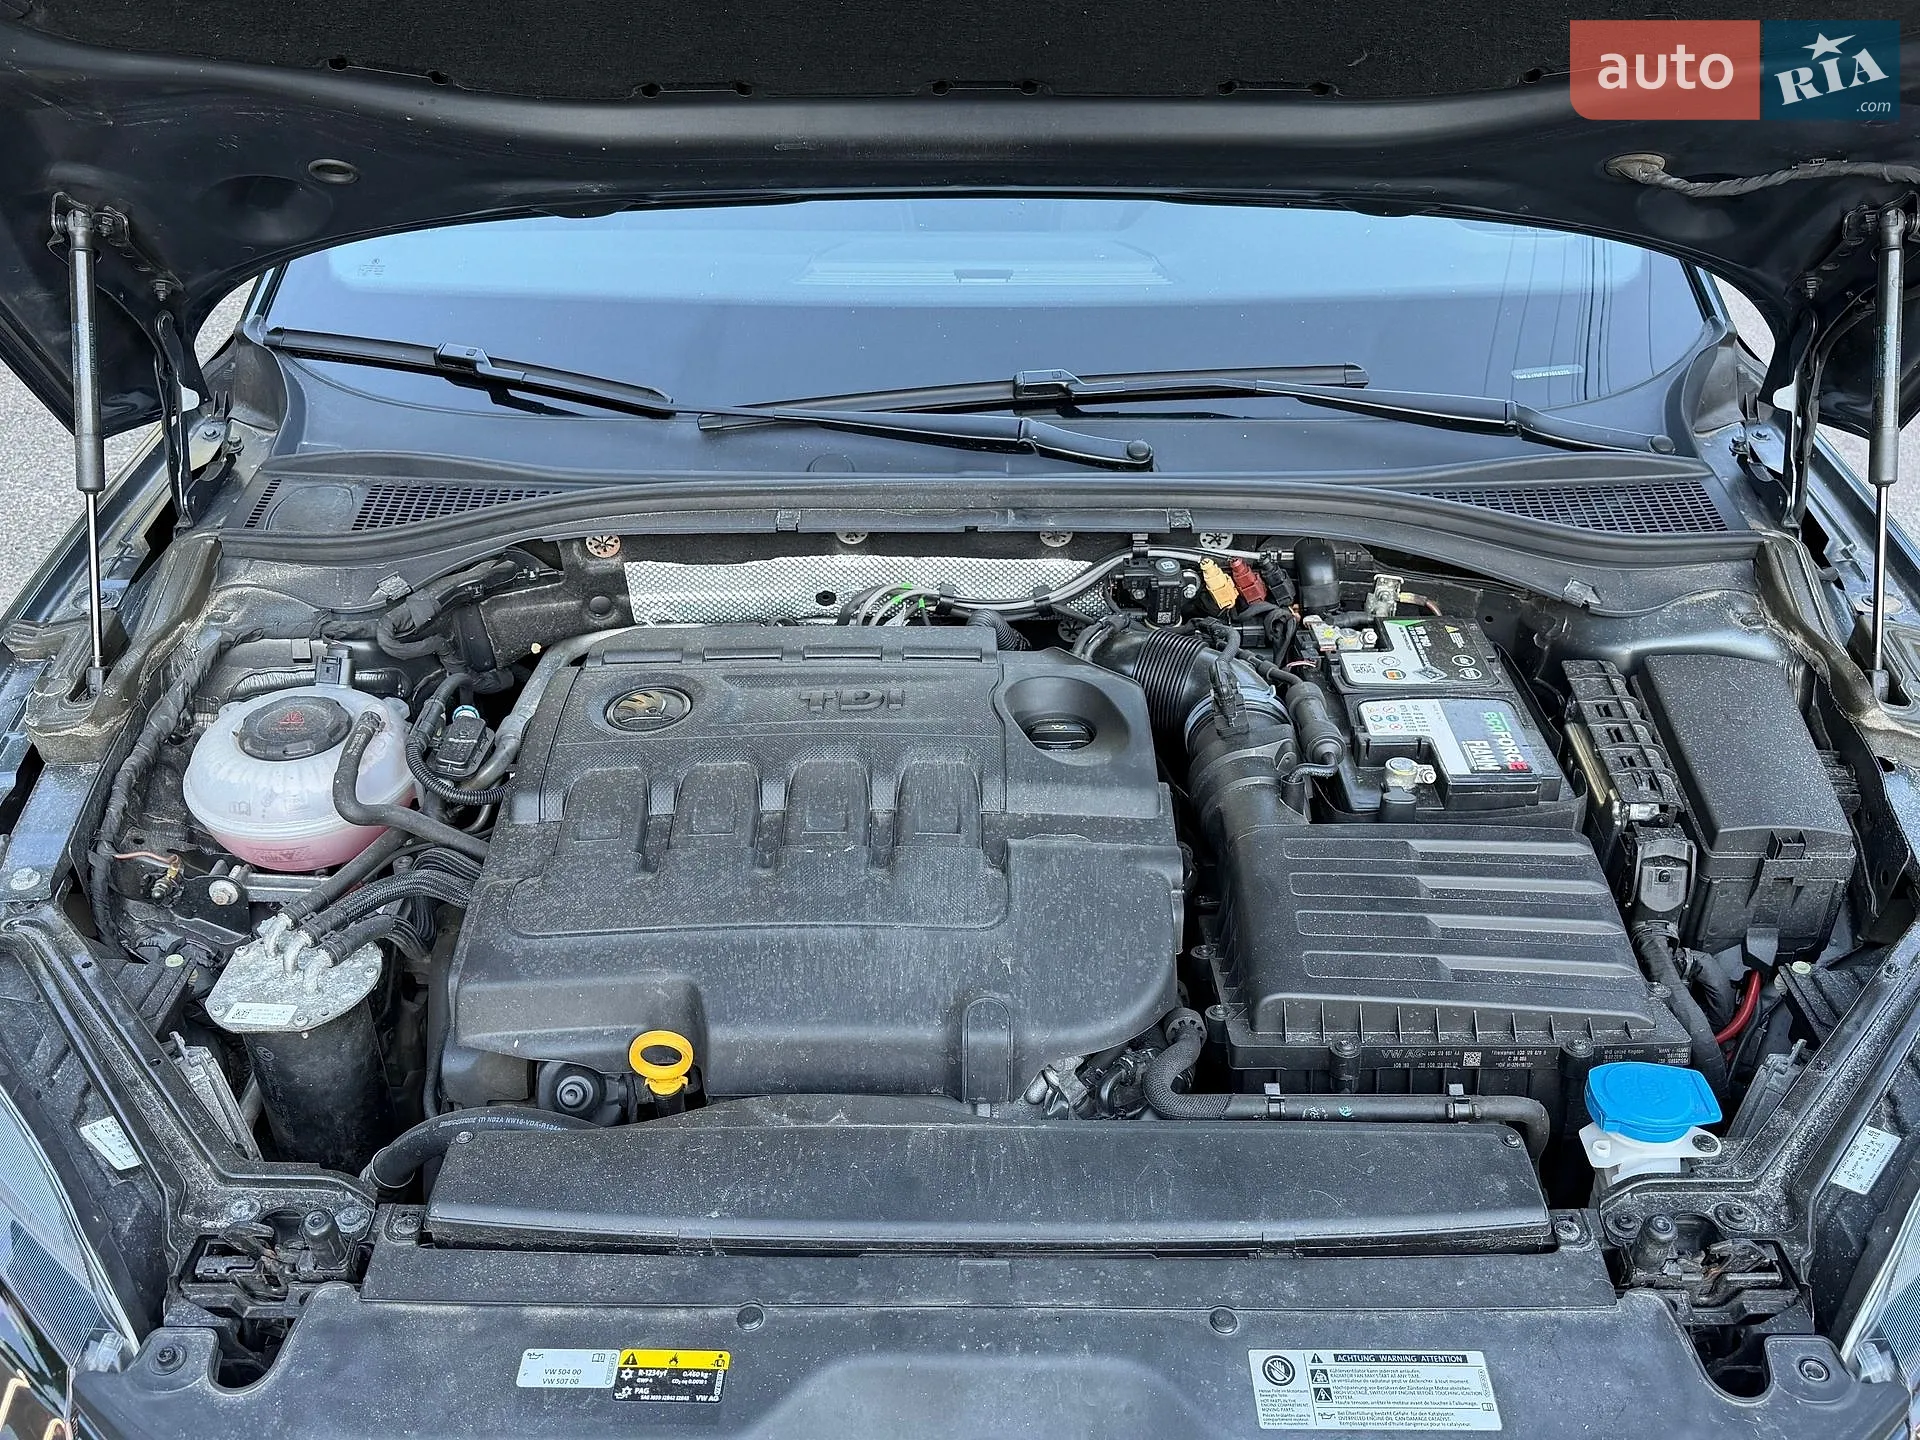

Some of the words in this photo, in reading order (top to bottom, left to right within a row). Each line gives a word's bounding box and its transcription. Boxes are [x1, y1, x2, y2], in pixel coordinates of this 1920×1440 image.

[799, 689, 905, 712] TDI
[1467, 740, 1502, 770] FIAMM
[1381, 1050, 1404, 1058] VW
[1404, 1048, 1424, 1058] AG
[638, 1370, 668, 1378] R-1234yf
